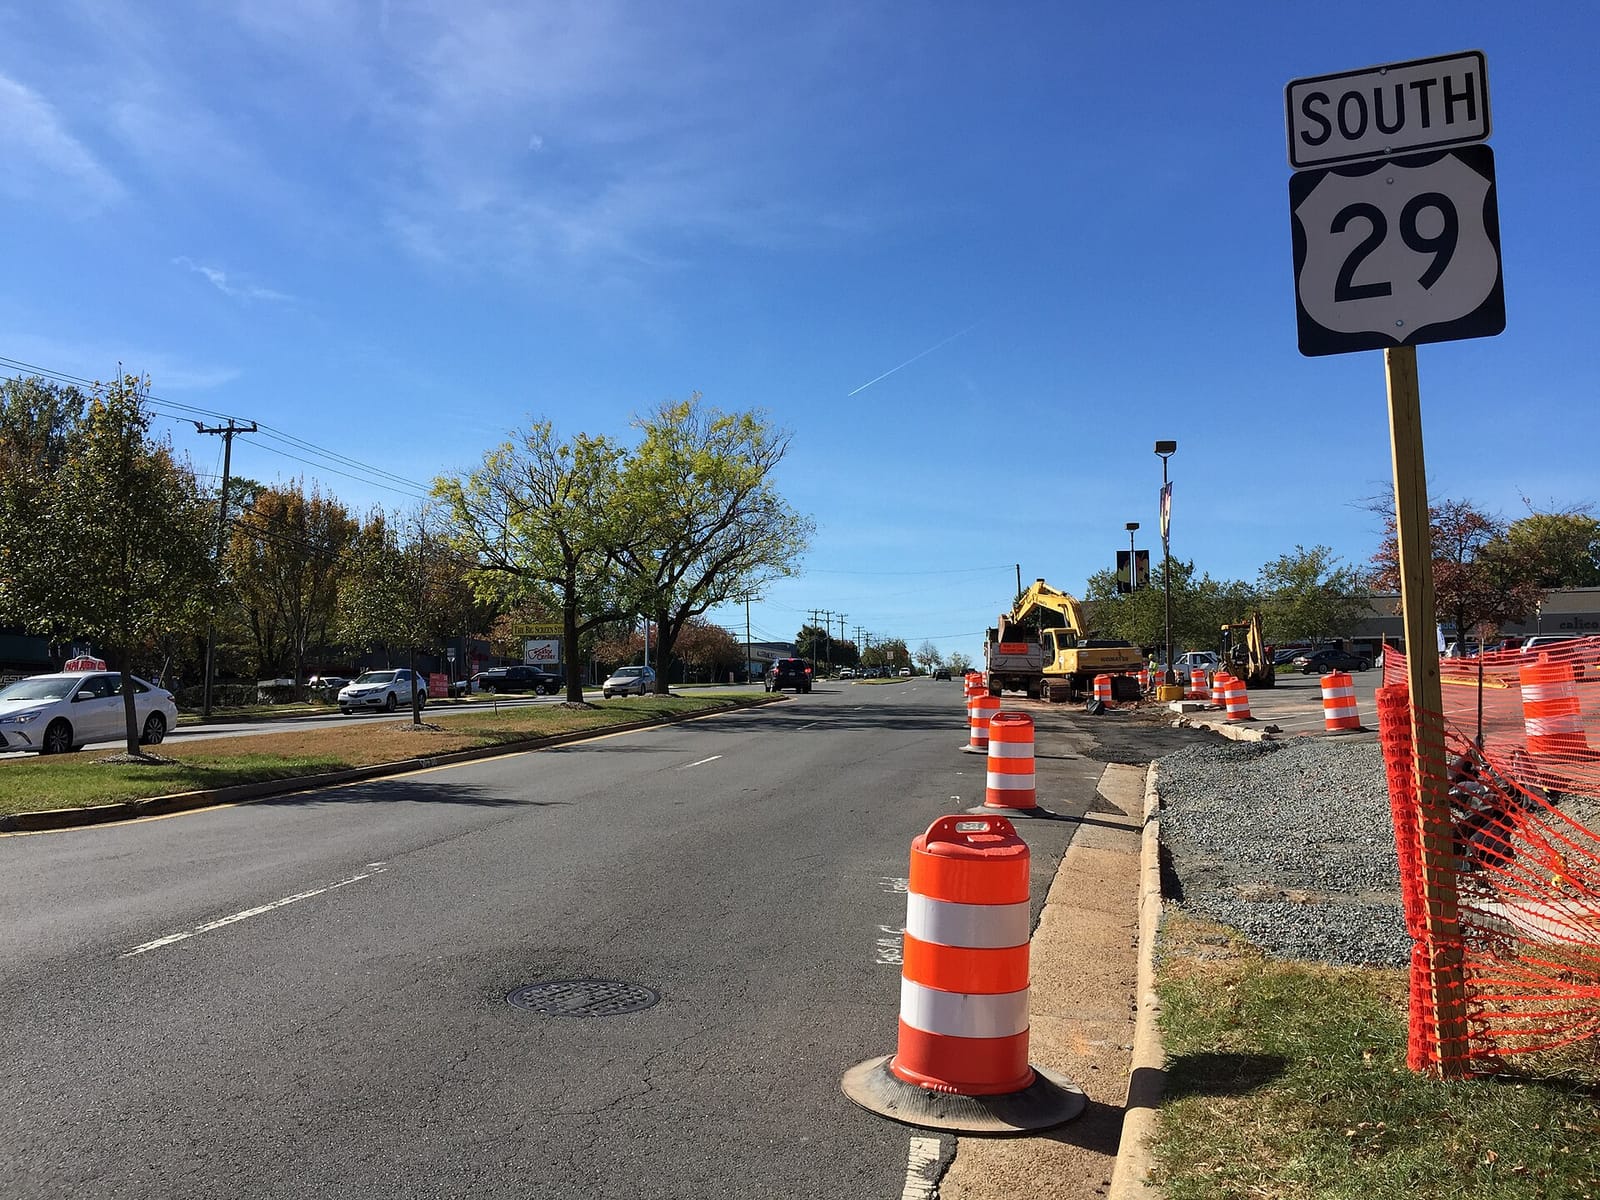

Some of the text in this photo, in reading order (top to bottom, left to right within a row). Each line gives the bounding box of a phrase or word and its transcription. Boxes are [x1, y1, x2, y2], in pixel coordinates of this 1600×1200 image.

[1300, 72, 1477, 146] SOUTH
[1329, 192, 1459, 303] 29
[534, 625, 554, 634] SCREEN
[1560, 616, 1599, 629] calico
